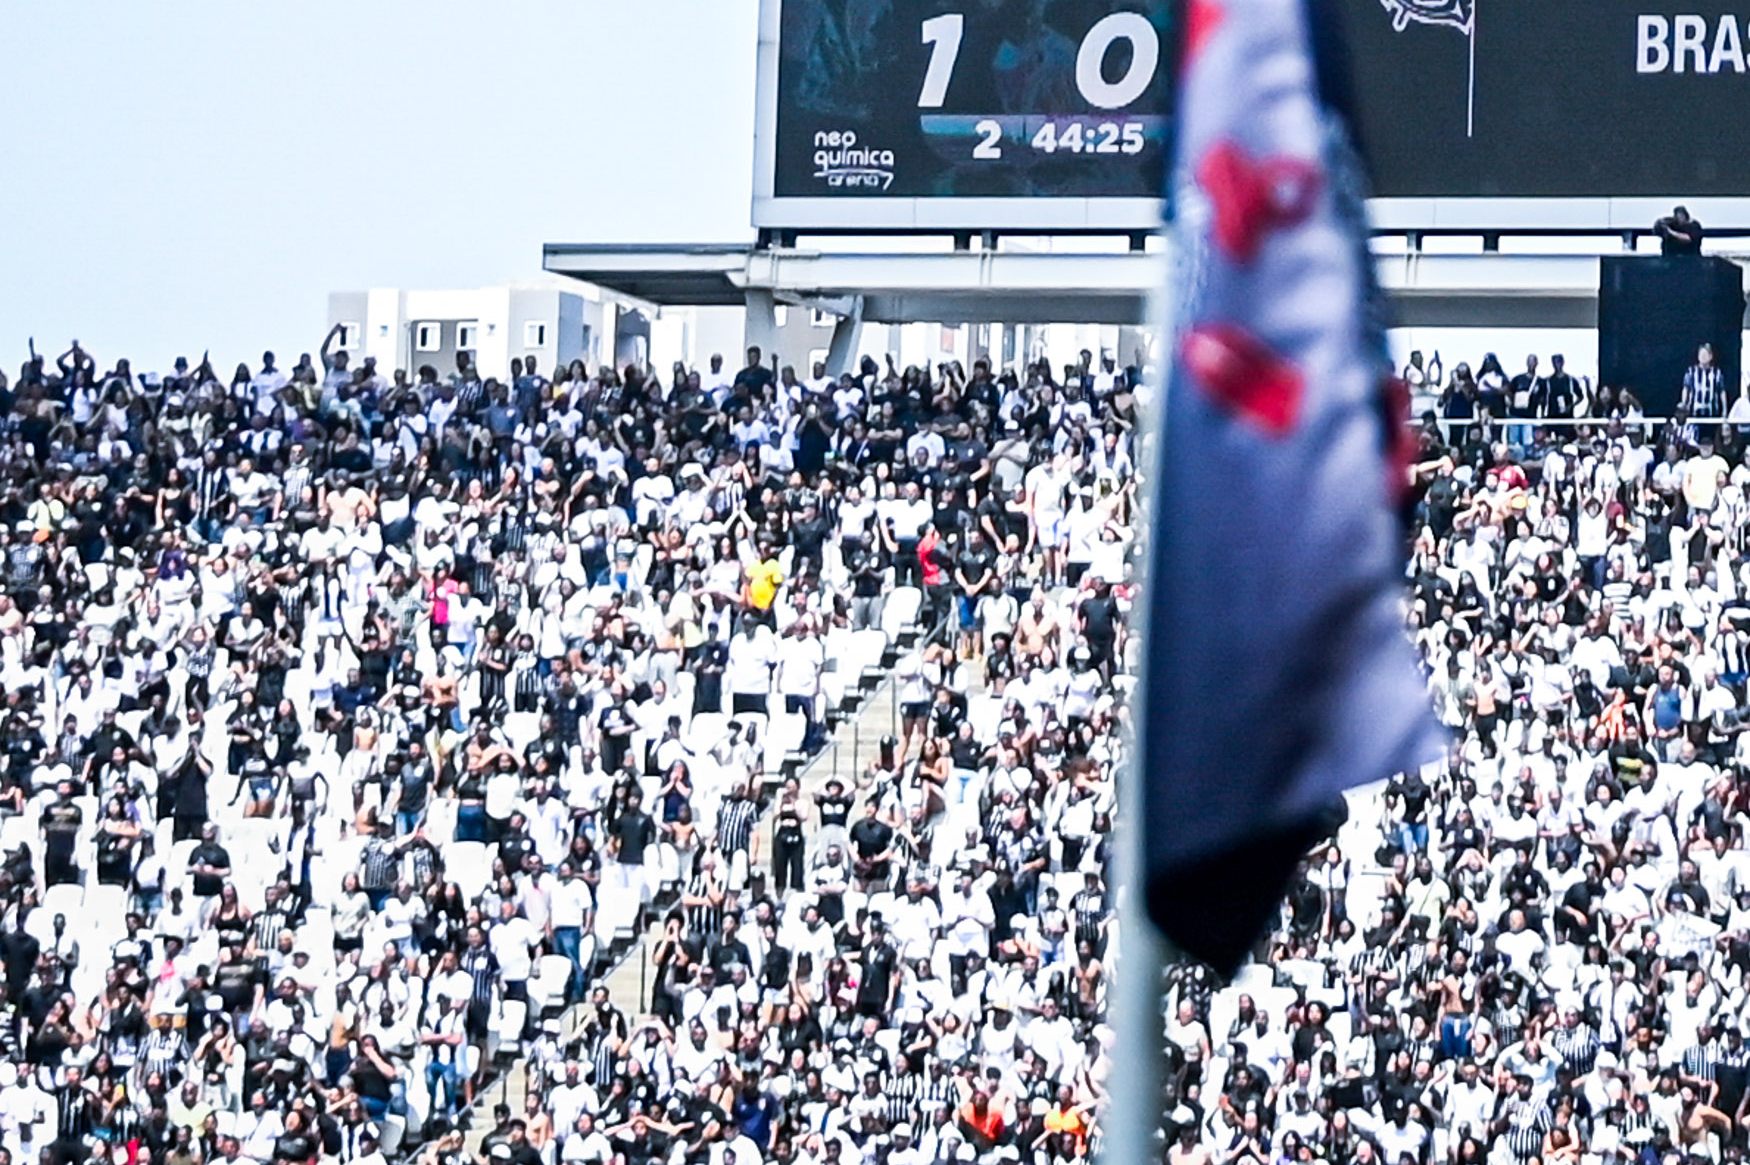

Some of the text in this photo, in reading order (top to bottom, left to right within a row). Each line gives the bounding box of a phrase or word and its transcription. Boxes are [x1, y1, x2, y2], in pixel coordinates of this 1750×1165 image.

[917, 11, 1159, 110] 1 0
[972, 118, 1145, 159] 2 44:25
